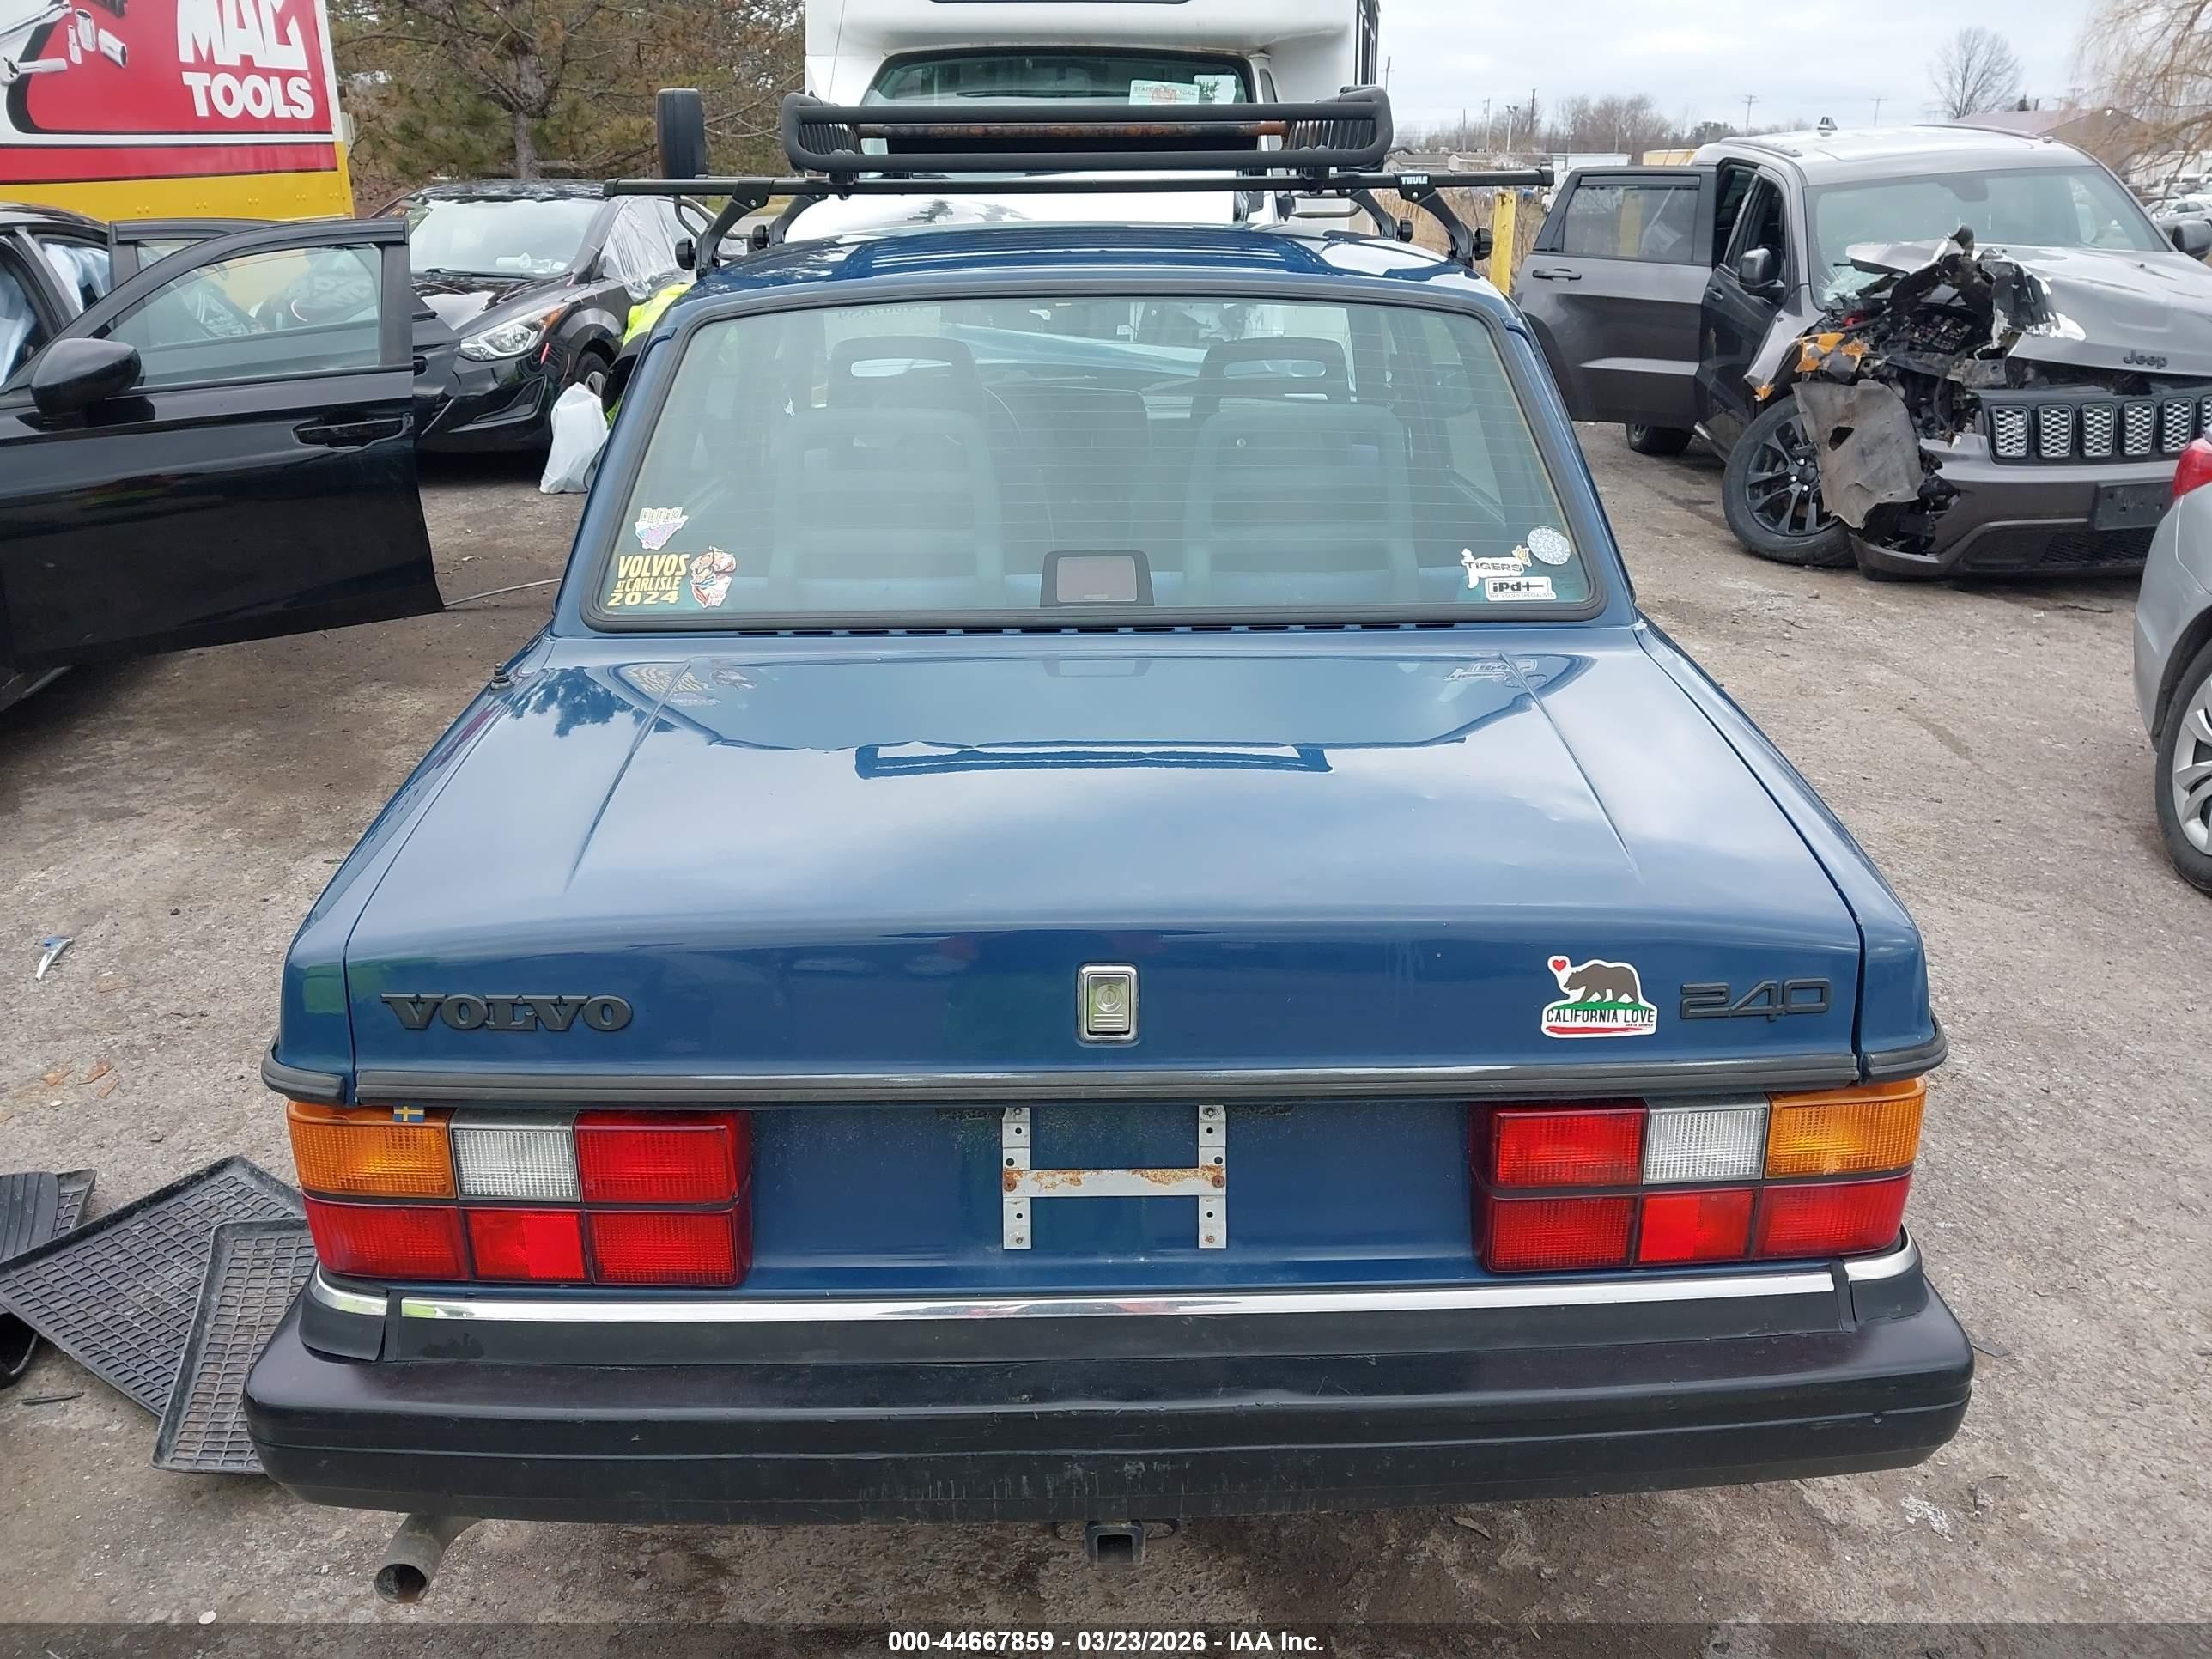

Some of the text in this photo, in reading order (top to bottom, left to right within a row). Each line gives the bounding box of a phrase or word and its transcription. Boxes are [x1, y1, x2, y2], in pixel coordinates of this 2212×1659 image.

[177, 0, 308, 70] MAC
[181, 71, 314, 119] TOOLS
[1401, 176, 1428, 185] THULE
[2123, 349, 2168, 369] Jeep
[618, 554, 690, 579] VOLVOS
[1463, 561, 1522, 572] TIGERS
[624, 576, 682, 592] CARLISLE
[607, 592, 680, 606] 2024
[1680, 977, 1832, 1022] 240
[380, 993, 634, 1031] VOLVO
[1546, 1008, 1655, 1024] CALIFORNIA LOVE
